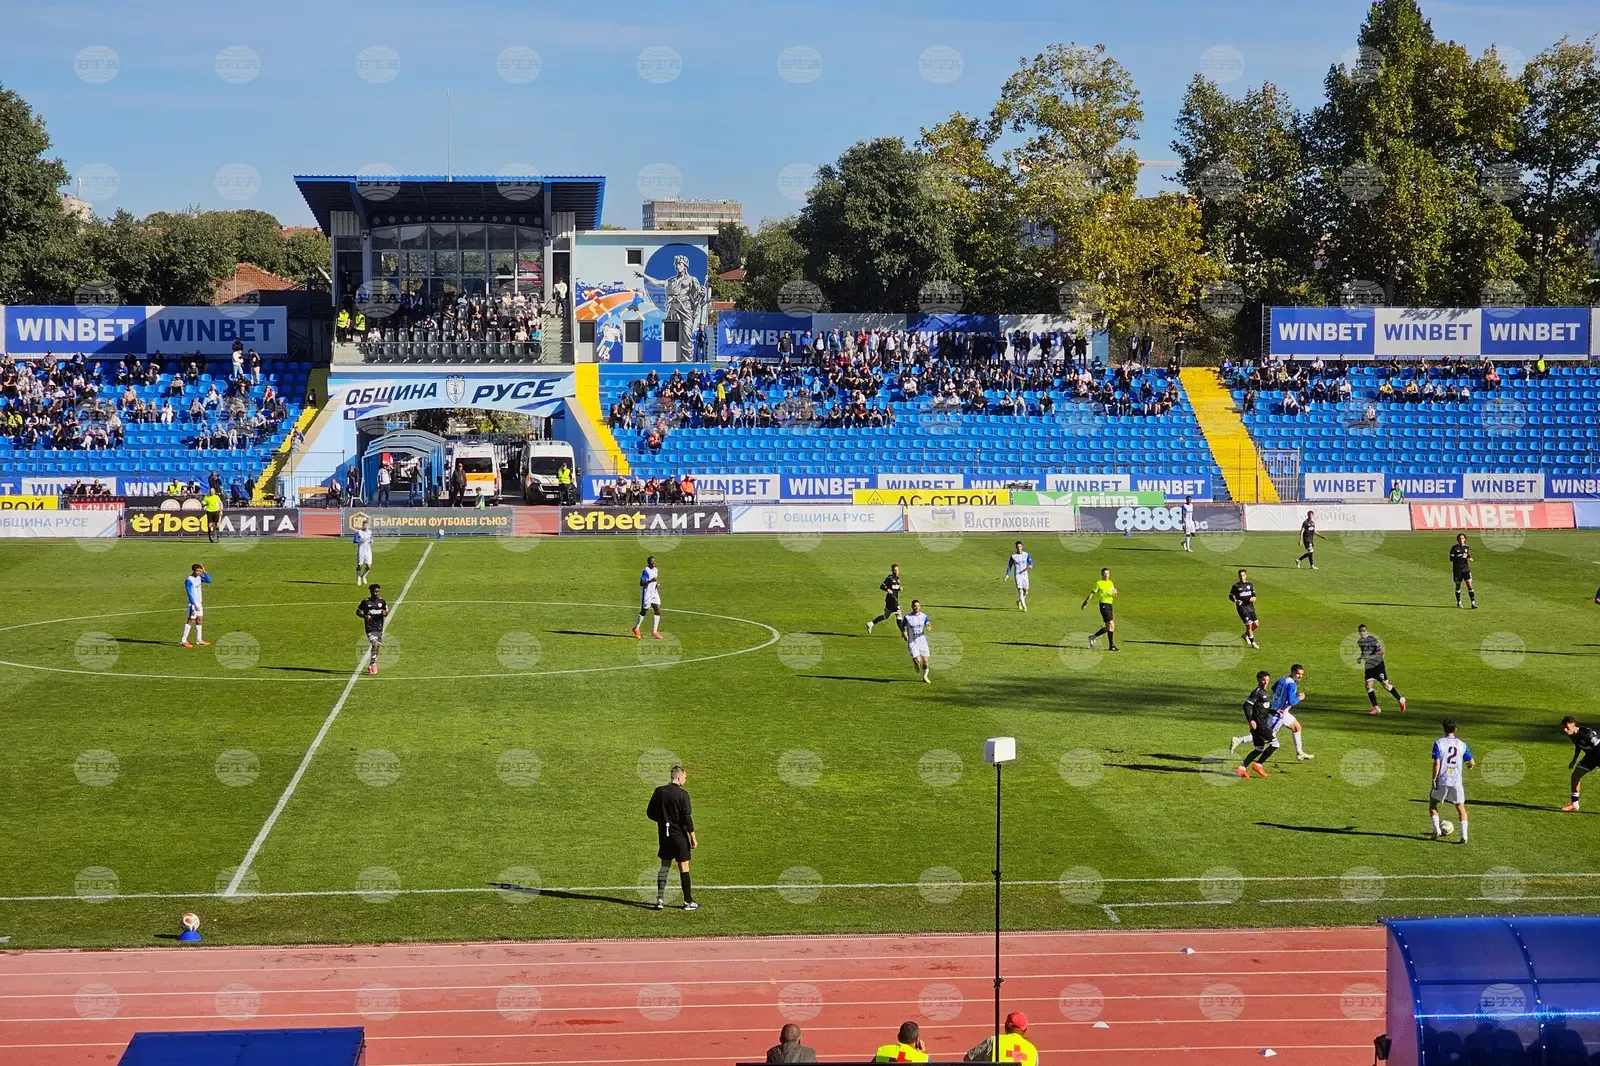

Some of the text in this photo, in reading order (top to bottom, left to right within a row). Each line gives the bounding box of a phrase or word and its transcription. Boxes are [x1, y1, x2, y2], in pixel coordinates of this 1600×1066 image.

[16, 318, 135, 342] WINBET
[159, 319, 275, 342] WINBET
[1278, 322, 1367, 341] WINBET
[1383, 323, 1473, 341] WINBET
[1489, 322, 1580, 341] WINBET
[345, 377, 561, 406] ОБЩИНА РУСЕ
[789, 478, 869, 496] WINBET
[1137, 480, 1205, 495] WINBET
[1313, 479, 1376, 493] WINBET
[1471, 480, 1536, 493] WINBET
[56, 518, 88, 527] РУСЕ
[218, 515, 296, 532] ЛИГА
[373, 517, 427, 527] БЪЛГАРСКИ
[428, 516, 478, 527] ФУТБОЛЕН
[479, 516, 508, 526] СЪЮЗ
[567, 511, 726, 531] efbet ЛИГА
[784, 513, 875, 524] ОБЩИНА РУСЕ
[963, 512, 1050, 528] ЗАСТРАХОВАНЕ
[1422, 505, 1534, 528] WINBET
[1447, 746, 1458, 764] 2
